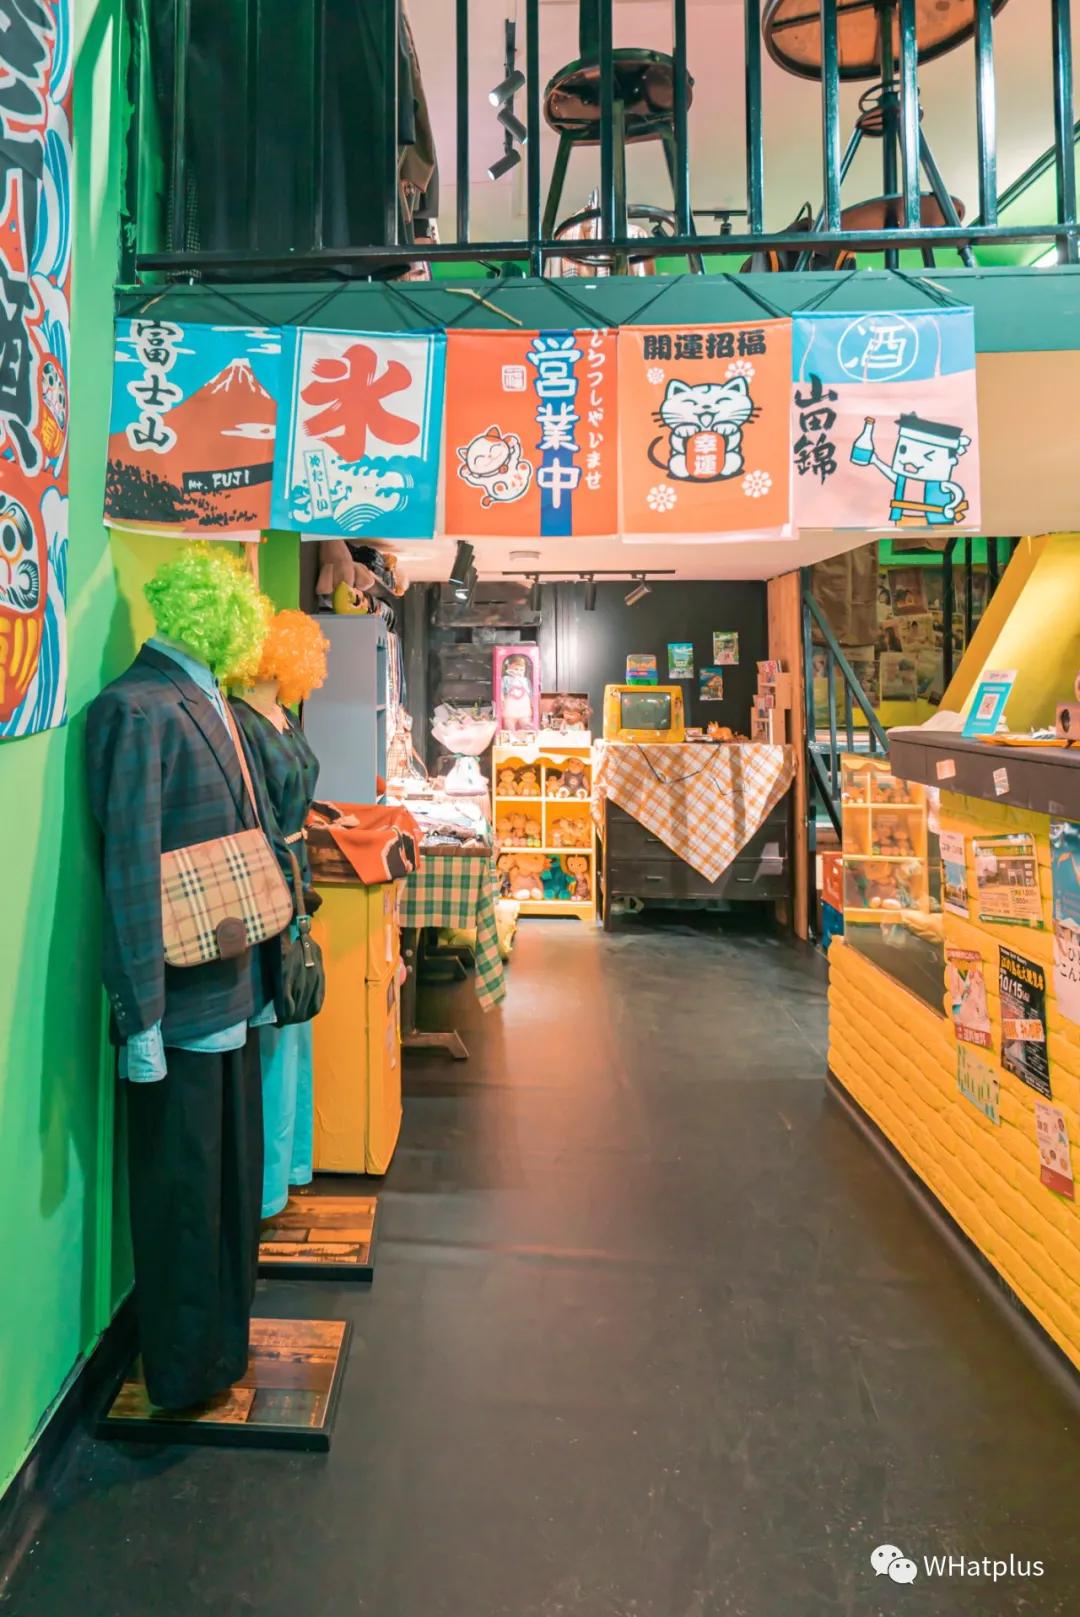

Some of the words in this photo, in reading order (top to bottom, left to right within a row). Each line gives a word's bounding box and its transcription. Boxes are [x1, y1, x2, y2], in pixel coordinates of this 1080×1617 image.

[134, 321, 177, 447] 富士山
[643, 329, 767, 361] 開運招福
[843, 324, 908, 369] 酒
[300, 344, 421, 463] 氷
[526, 335, 584, 510] 営業中
[794, 373, 839, 486] 山田錦
[188, 479, 208, 490] Mt.
[212, 469, 250, 488] FUJI
[694, 433, 717, 476] 幸運
